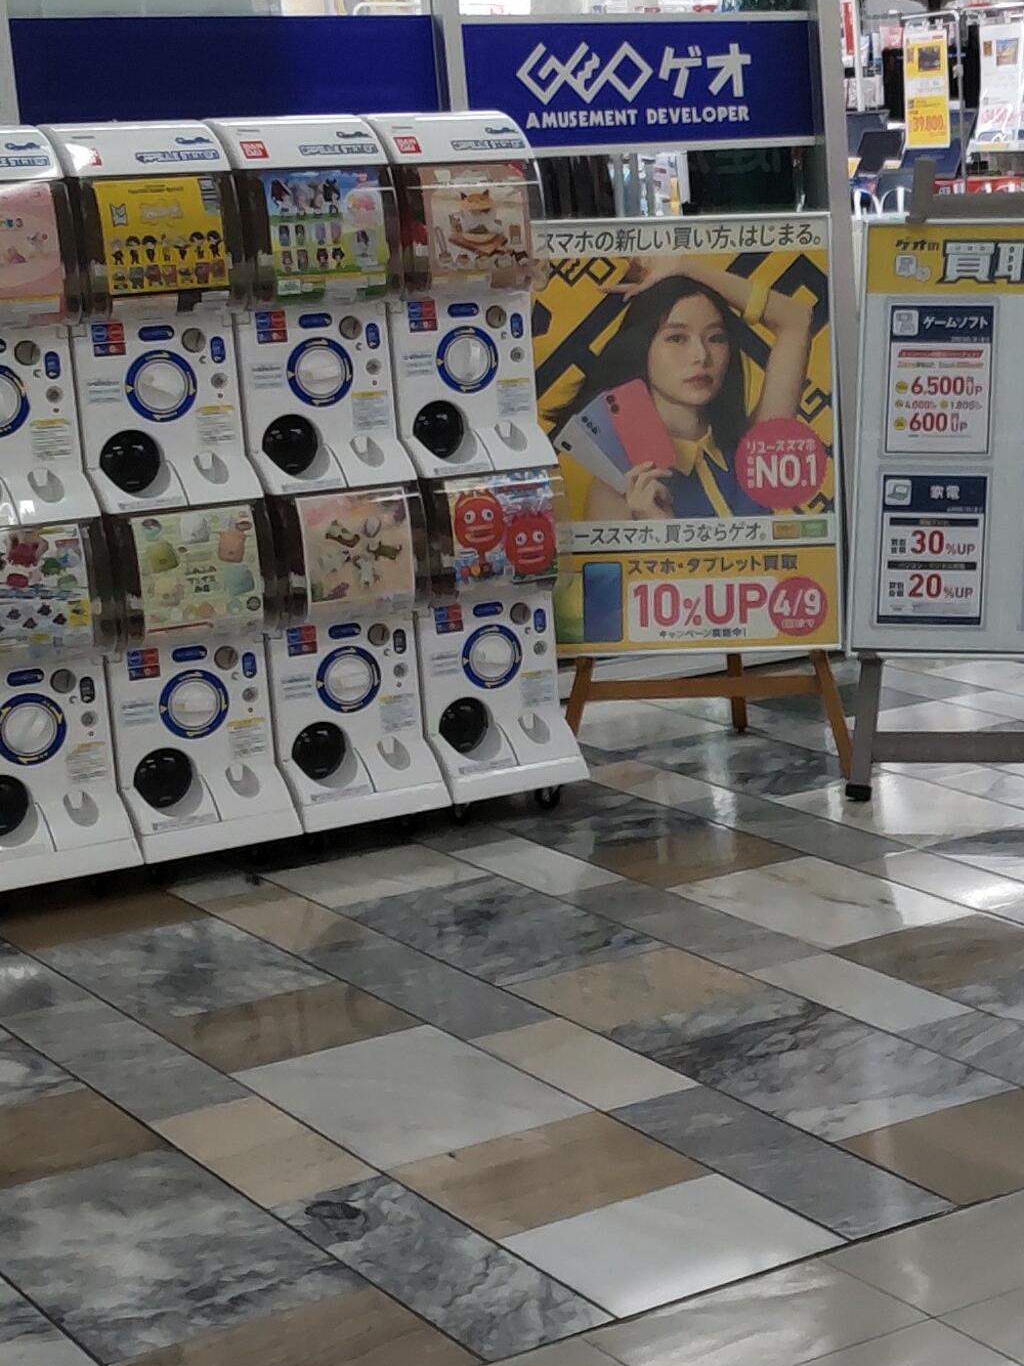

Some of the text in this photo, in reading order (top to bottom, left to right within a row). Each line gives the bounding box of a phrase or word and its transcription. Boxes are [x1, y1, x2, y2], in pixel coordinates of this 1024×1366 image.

[515, 40, 751, 105] GEO ゲオ
[526, 105, 750, 129] AMUSEMENT DEVELOPER
[536, 224, 822, 253] スマホの新しい買い方、はじまる。
[923, 316, 989, 330] ゲームソフト
[747, 438, 816, 453] リユーススマホ
[756, 454, 817, 488] NO.1
[930, 485, 960, 500] 家電
[560, 522, 767, 546] ーススマホ、買うならゲオ。
[628, 553, 798, 576] スマホ・タブレット買取
[633, 583, 767, 628] 10%UP
[773, 589, 820, 617] 4/9
